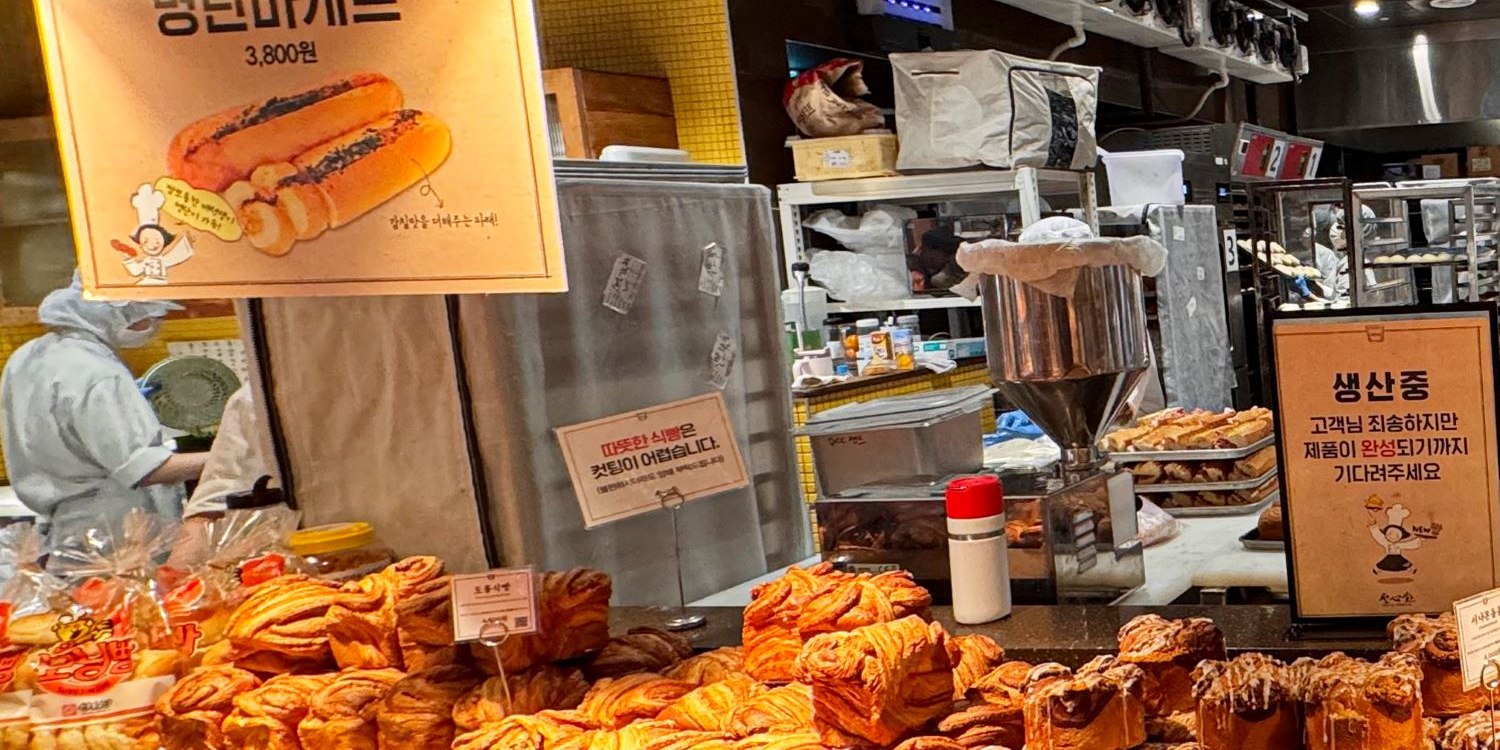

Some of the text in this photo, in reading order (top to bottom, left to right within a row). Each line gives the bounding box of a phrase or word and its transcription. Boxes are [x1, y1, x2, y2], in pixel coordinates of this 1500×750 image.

[245, 41, 318, 67] 3,800원
[1269, 145, 1281, 172] 2
[1309, 152, 1317, 176] 1
[1226, 235, 1235, 266] 3
[1333, 370, 1429, 403] 생산중
[1310, 412, 1458, 434] 고객님 죄송하지만
[601, 422, 697, 458] 따뜻한 식빵은
[1304, 437, 1469, 459] 제품이 완성되기까지
[590, 436, 720, 480] 컷팅이 어렵습니다.
[1334, 462, 1441, 483] 기다려주세요
[1412, 525, 1431, 533] NEW
